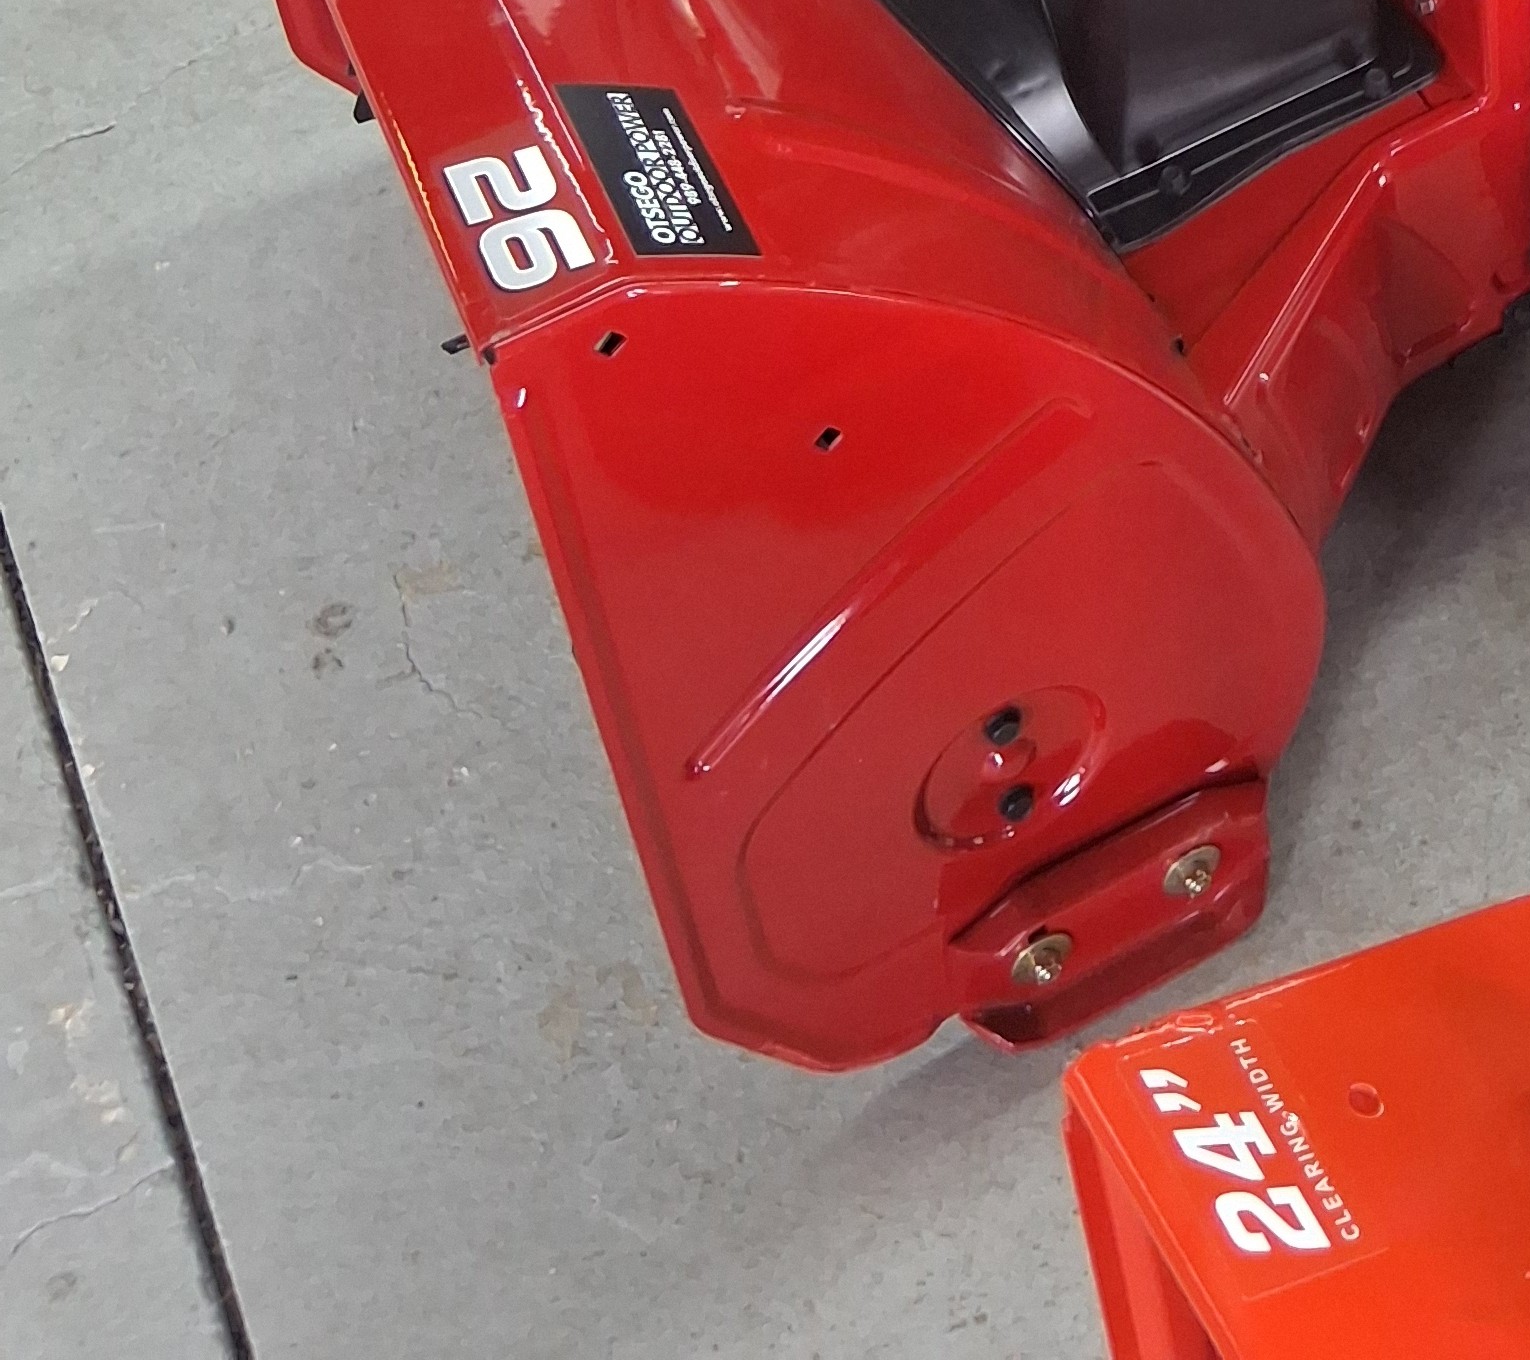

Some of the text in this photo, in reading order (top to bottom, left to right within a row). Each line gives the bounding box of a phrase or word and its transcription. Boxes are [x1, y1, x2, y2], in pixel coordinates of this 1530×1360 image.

[442, 145, 596, 291] 26
[606, 92, 704, 243] OUTDOOR POWER
[622, 171, 674, 244] OTSEGO
[1230, 1038, 1360, 1241] CLEARING WIDTH
